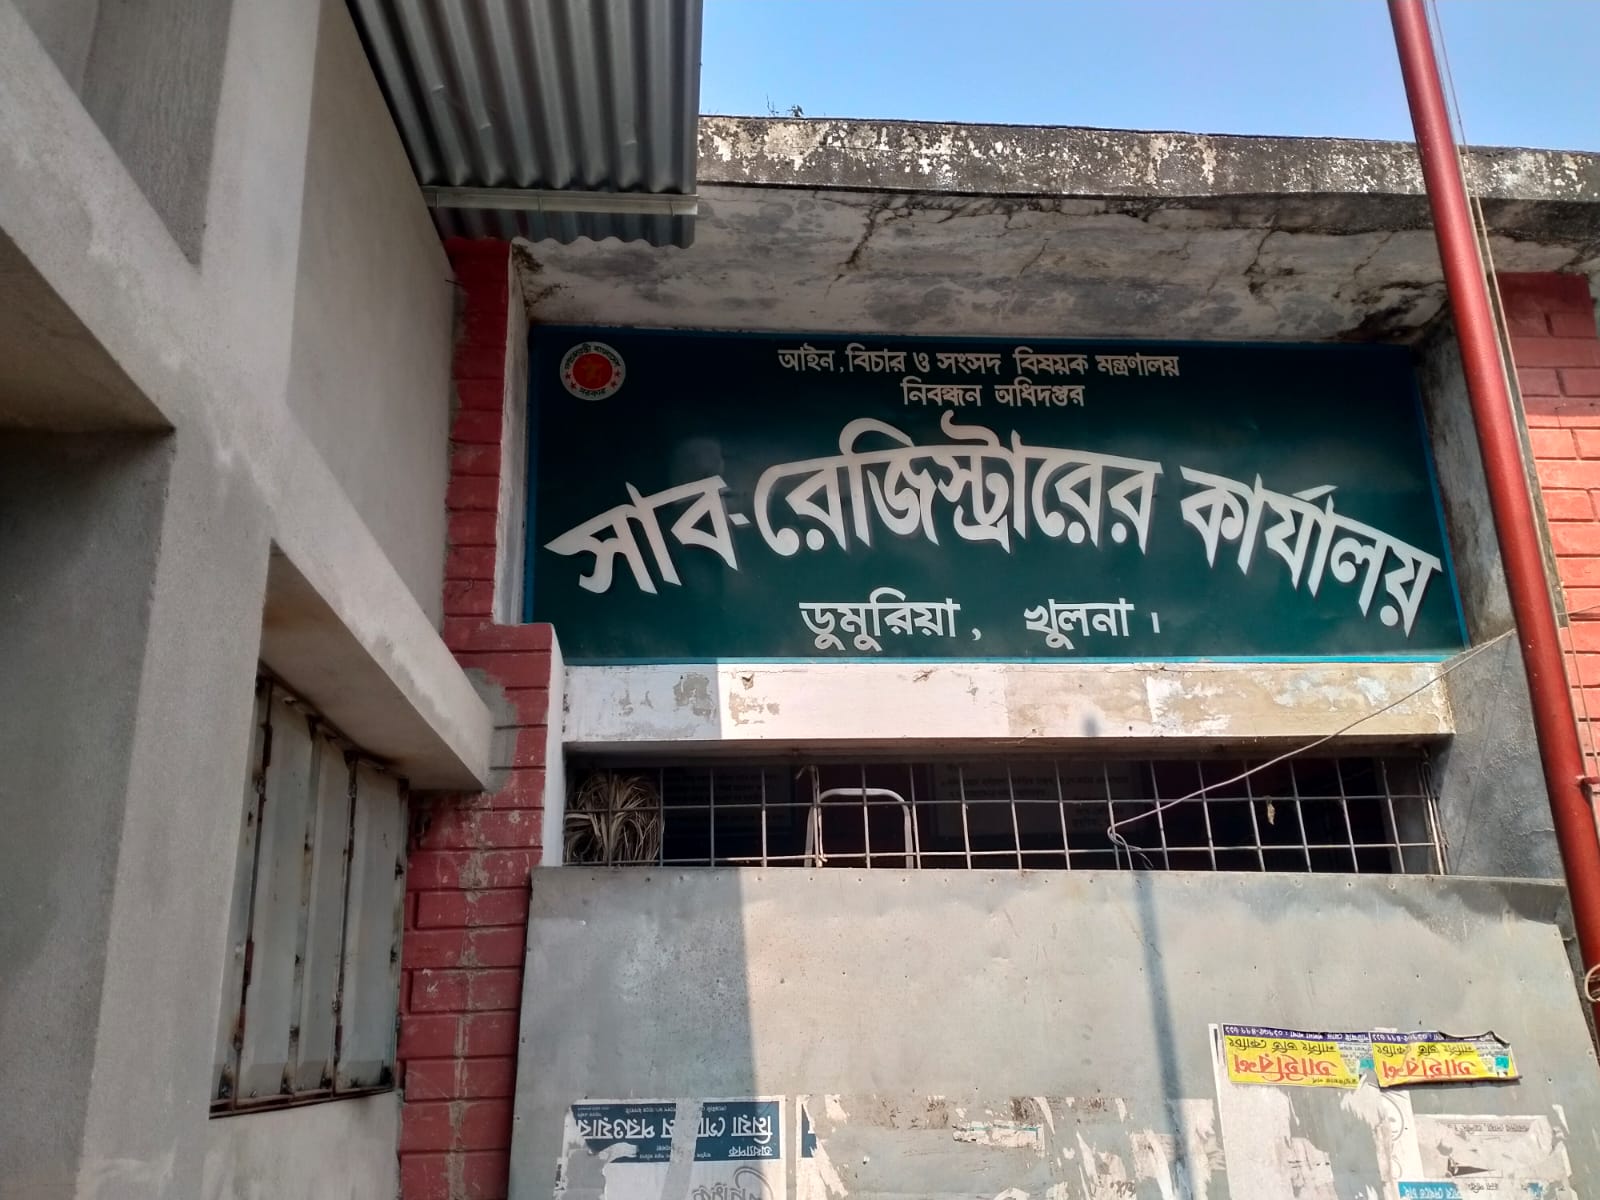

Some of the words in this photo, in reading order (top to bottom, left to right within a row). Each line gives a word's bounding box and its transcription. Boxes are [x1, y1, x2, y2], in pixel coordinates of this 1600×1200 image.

[845, 343, 907, 373] বিচার
[912, 352, 931, 373] ও
[936, 352, 1001, 375] সংসদ
[1012, 346, 1089, 375] বিষয়ক
[1095, 352, 1180, 377] মন্ত্রণালয়
[901, 376, 983, 407] নিবন্ধন
[994, 376, 1086, 407] অধিদপ্তর
[1180, 466, 1443, 638] কার্যালয়
[1229, 1038, 1267, 1052] কোচিং
[1271, 1041, 1298, 1055] ভর্তি
[1302, 1042, 1337, 1056] নার্সিং
[1233, 1053, 1338, 1083] আইরিশ
[731, 1115, 773, 1145] মিয়া
[728, 1145, 773, 1158] অধ্যাপক
